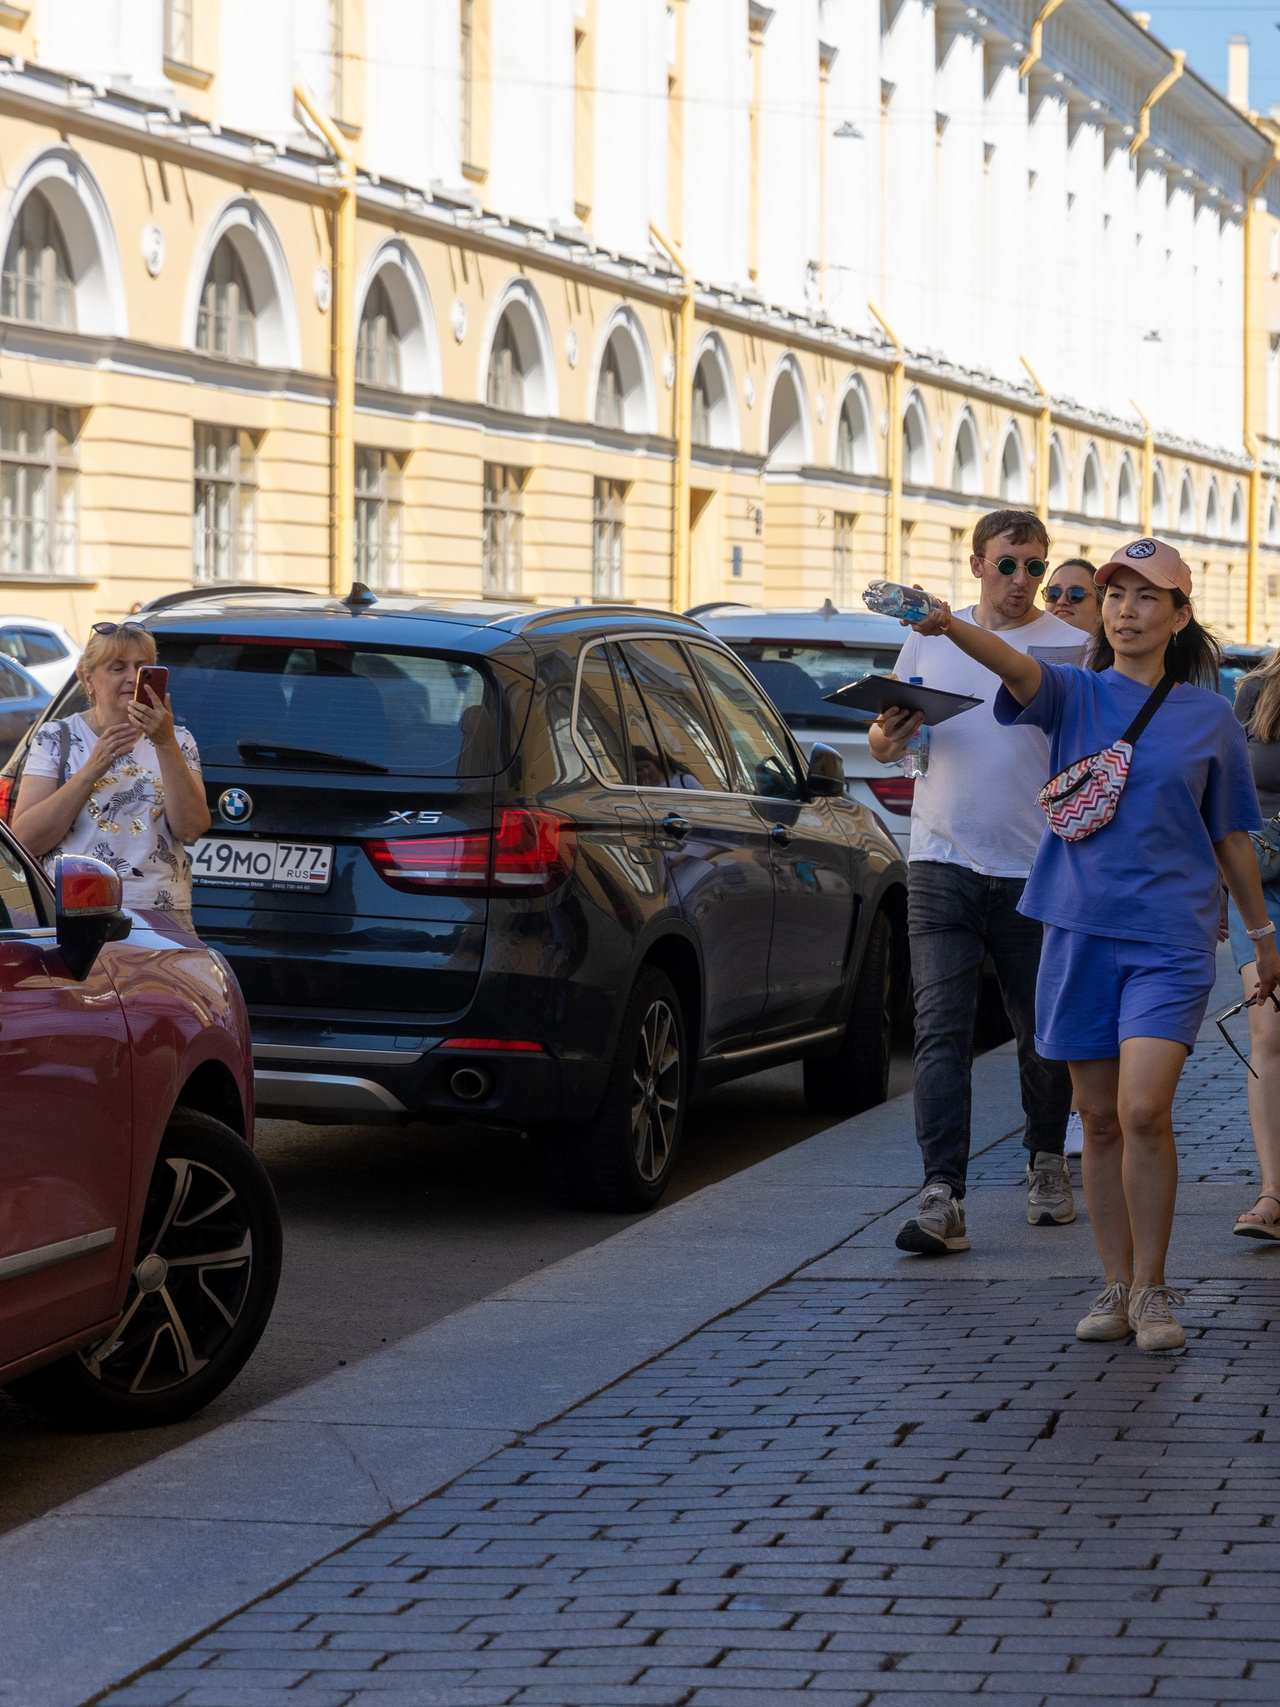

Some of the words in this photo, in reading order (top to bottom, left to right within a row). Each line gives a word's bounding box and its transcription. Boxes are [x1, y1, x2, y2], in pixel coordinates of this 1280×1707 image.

[383, 811, 443, 824] X5
[280, 846, 323, 870] 777
[287, 869, 309, 879] RUS
